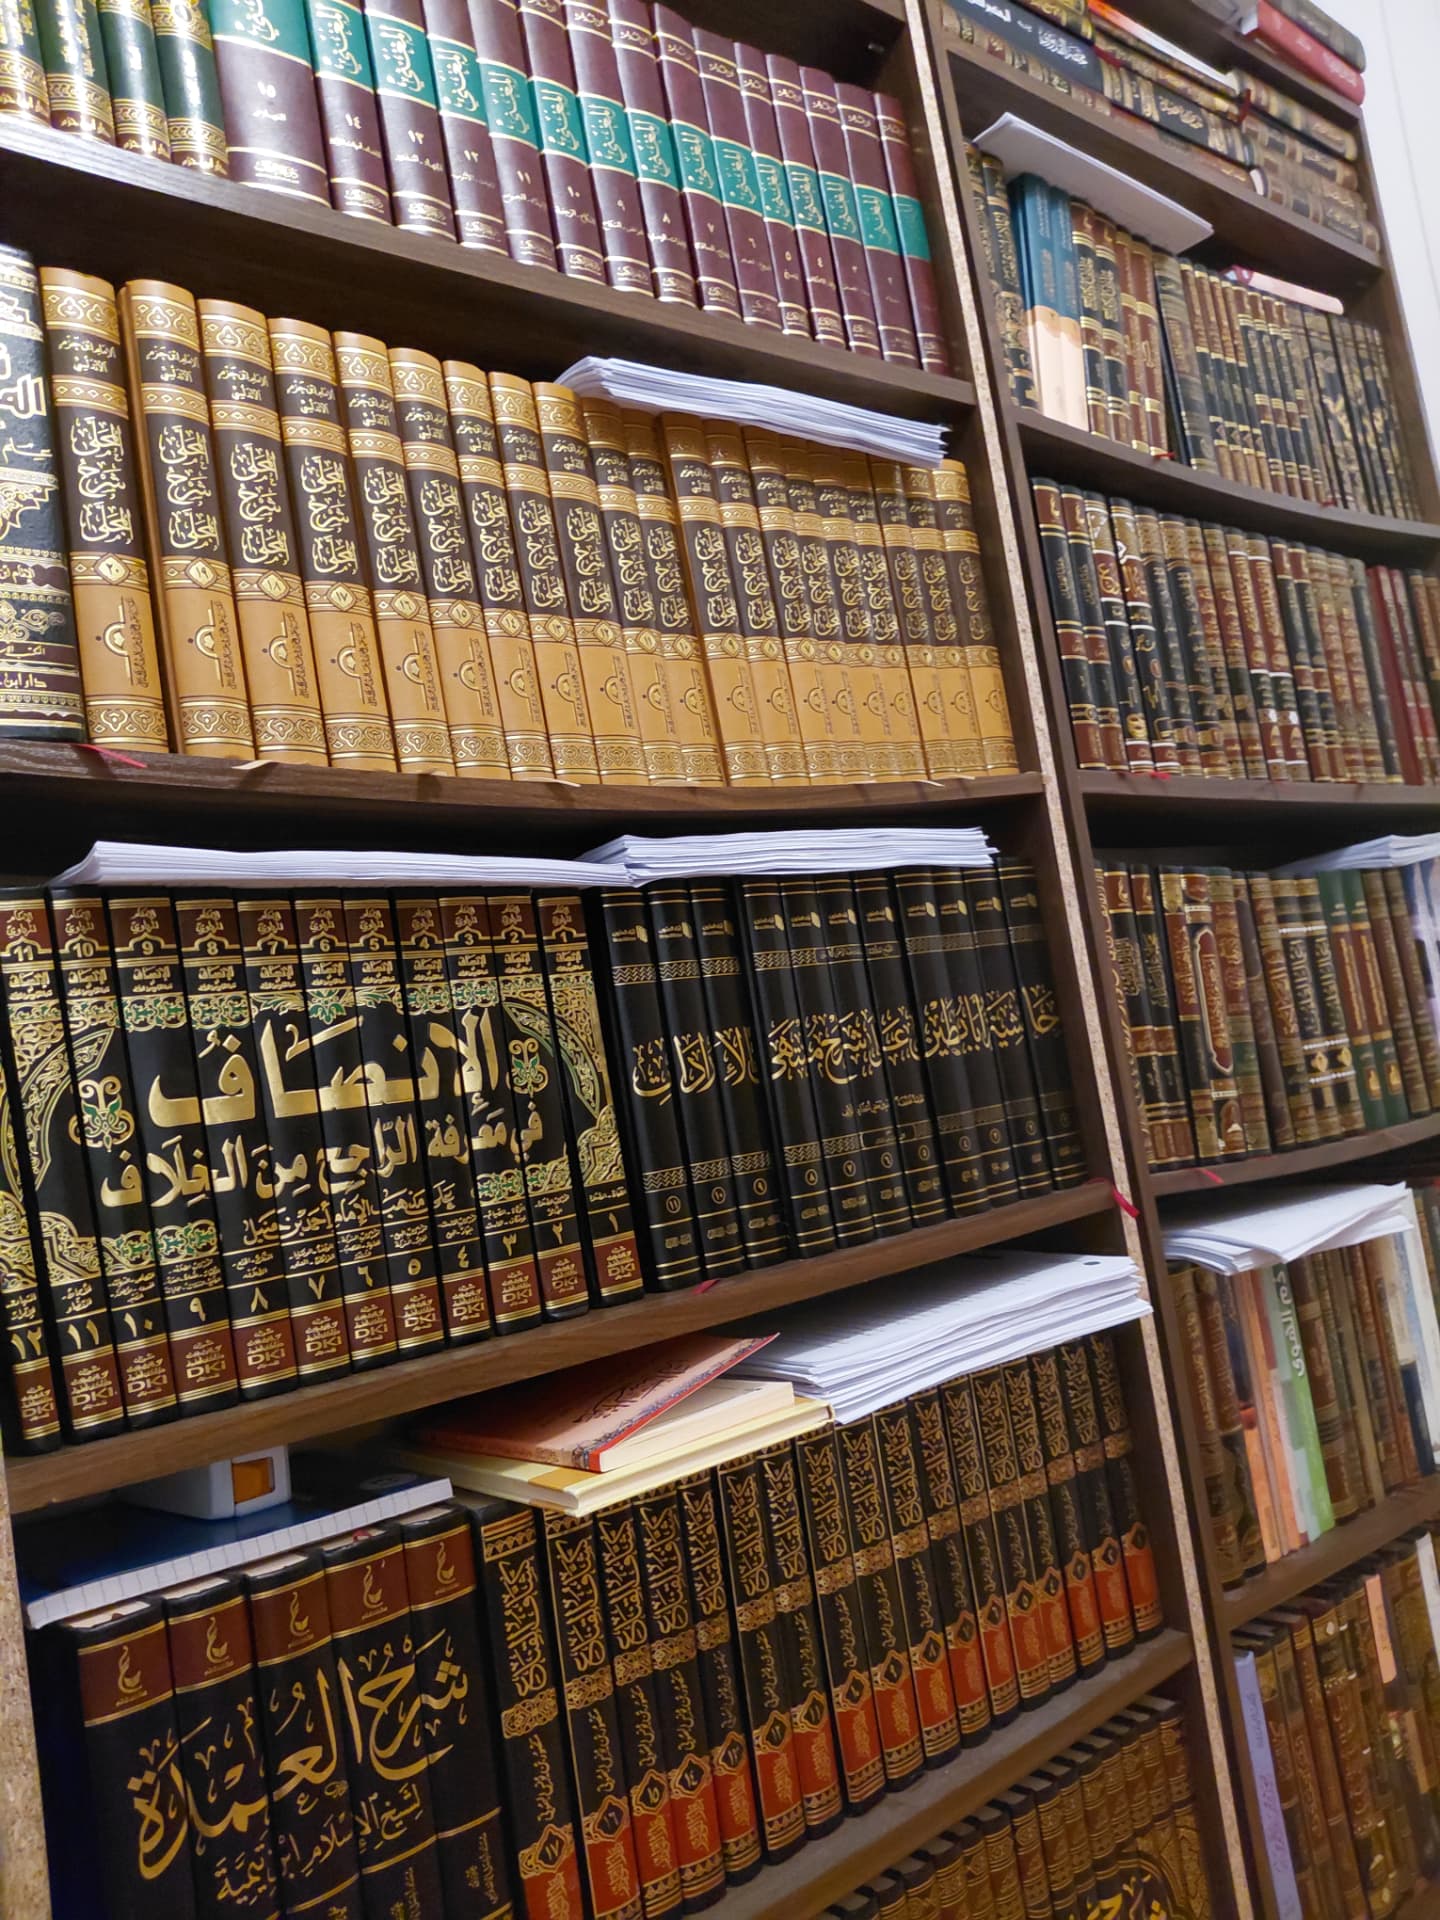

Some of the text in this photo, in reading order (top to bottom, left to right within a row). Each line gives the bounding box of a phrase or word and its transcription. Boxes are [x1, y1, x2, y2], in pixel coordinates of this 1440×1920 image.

[24, 673, 48, 689] دار
[320, 939, 330, 951] 6
[370, 938, 379, 951] 5
[420, 937, 430, 949] 4
[465, 933, 474, 945] 3
[510, 931, 519, 943] 2
[560, 931, 567, 942] 1
[14, 946, 34, 961] 11
[73, 942, 93, 957] 10
[142, 941, 153, 955] 9
[207, 941, 218, 955] 8
[267, 941, 278, 955] 7
[100, 1101, 543, 1207] في معرفة الراجح من الخلاف
[370, 1188, 428, 1219] مذهب
[608, 1213, 619, 1233] ١
[552, 1223, 564, 1245] ٢
[503, 1233, 517, 1257] ٣
[408, 1258, 421, 1275] ٥
[457, 1246, 469, 1268] ٤
[357, 1266, 373, 1287] ٦
[608, 1262, 636, 1276] DKI
[308, 1274, 325, 1299] ٧
[552, 1275, 578, 1289] DKI
[251, 1288, 268, 1312] ٨
[502, 1288, 533, 1303] DKI
[189, 1297, 206, 1321] ٩
[453, 1301, 485, 1317] DKI
[124, 1312, 153, 1337] ١٠
[405, 1312, 436, 1329] DKI
[67, 1319, 99, 1349] ١١
[355, 1323, 387, 1340] DKI
[10, 1328, 42, 1359] ١٢
[306, 1334, 342, 1352] DKI
[247, 1347, 285, 1366] DKI
[186, 1360, 227, 1379] DKI
[127, 1374, 168, 1394] DKI
[73, 1387, 114, 1408] DKI
[22, 1397, 55, 1418] DKI
[358, 1629, 471, 1781] شرح
[374, 1783, 423, 1849] لشيخ
[215, 1830, 277, 1906] تيمية
